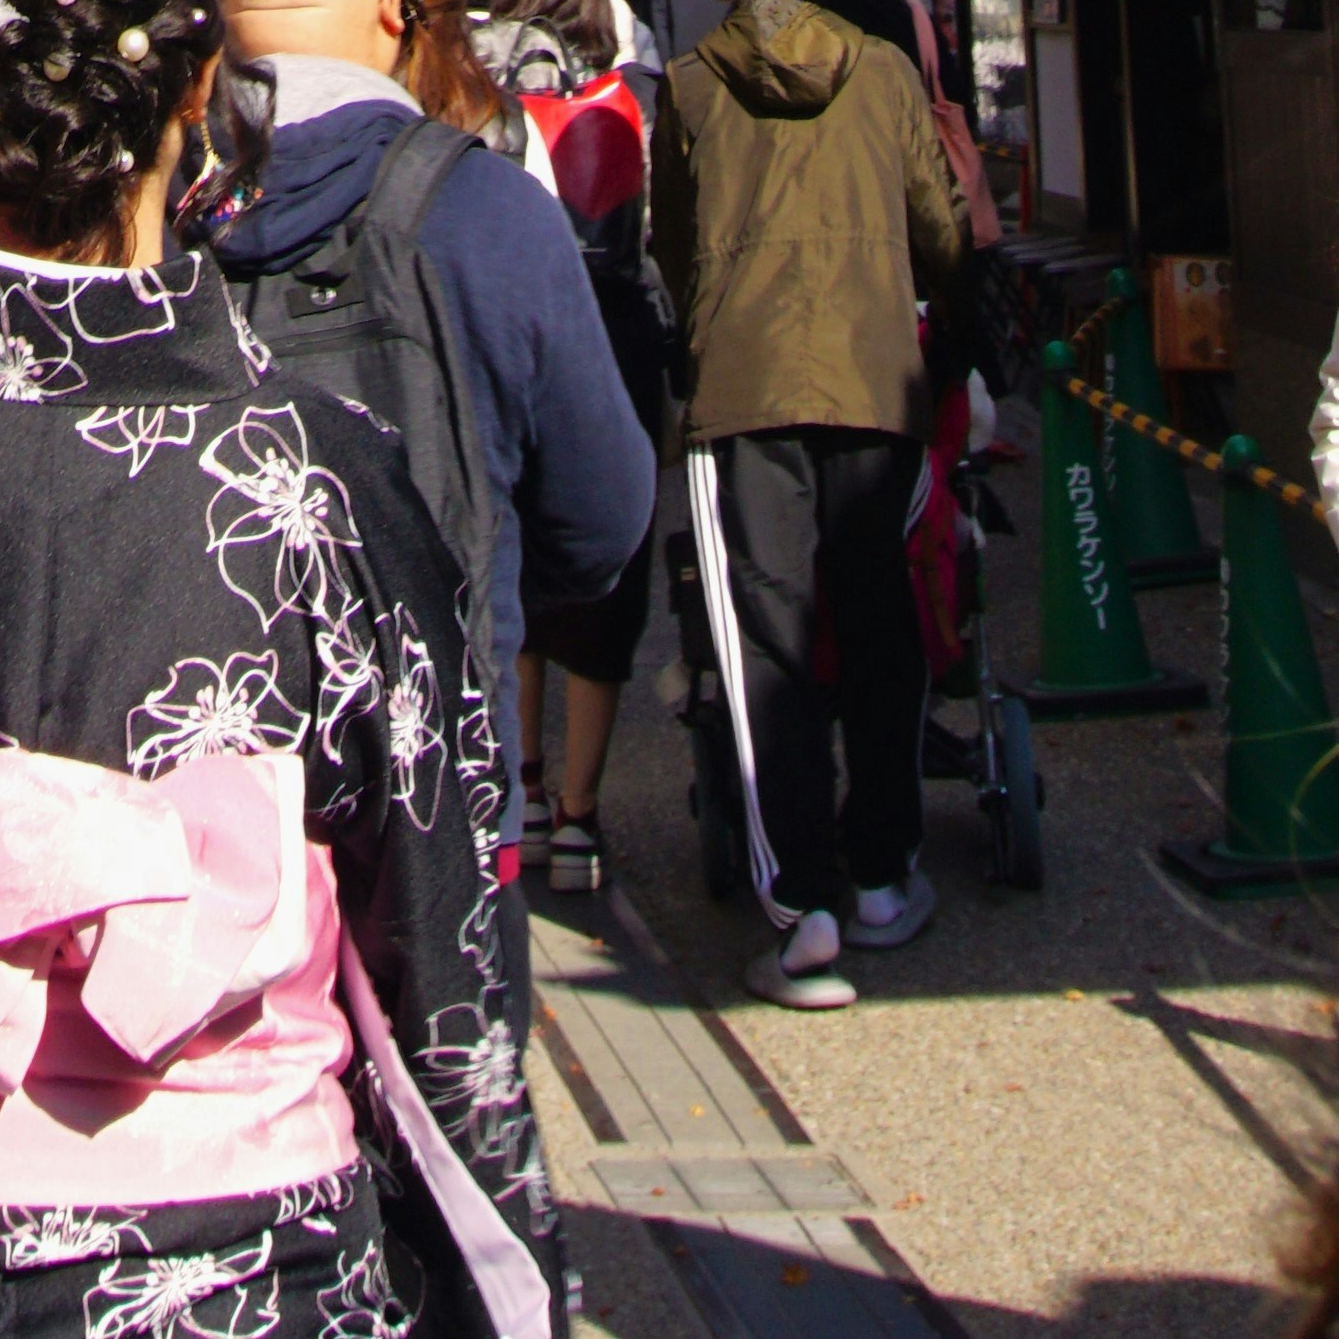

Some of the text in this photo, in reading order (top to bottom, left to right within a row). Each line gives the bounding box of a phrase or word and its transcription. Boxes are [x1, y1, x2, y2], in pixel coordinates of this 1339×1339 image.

[1066, 462, 1109, 630] カワラケンソー
